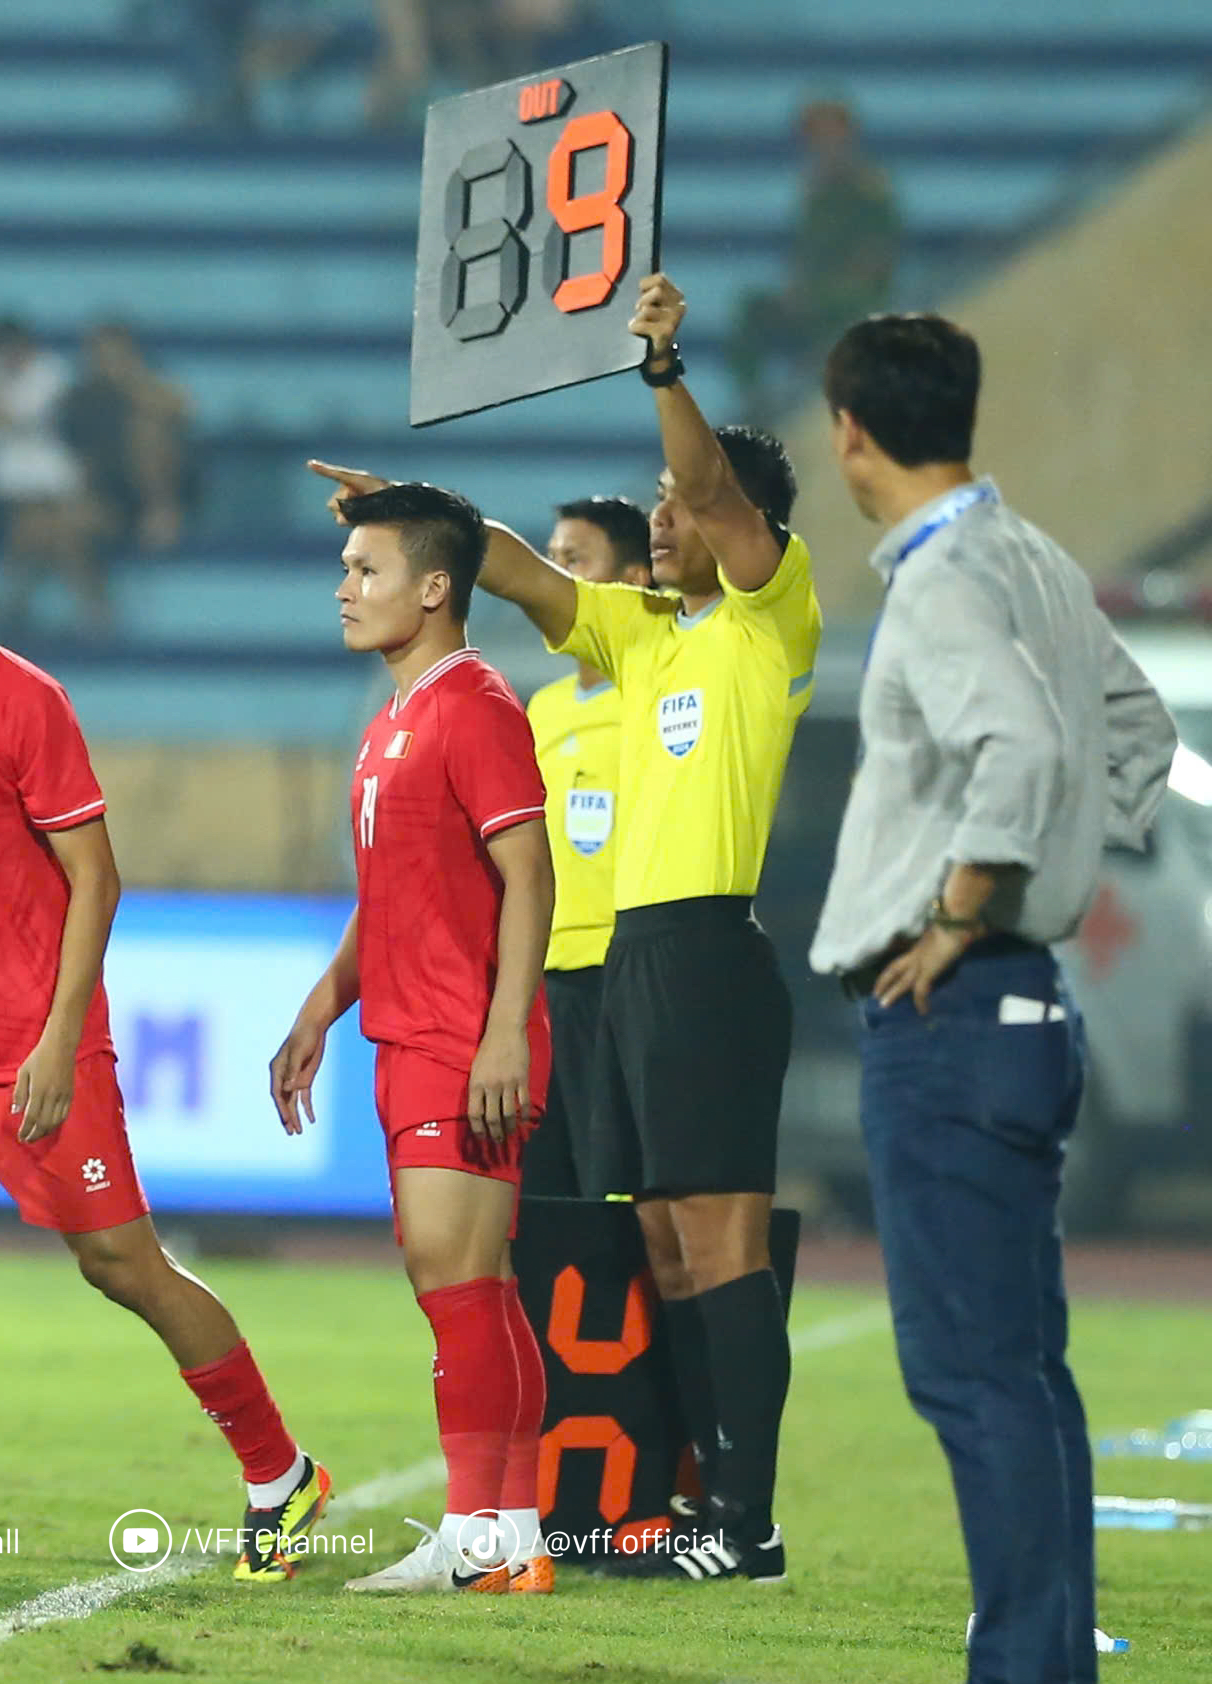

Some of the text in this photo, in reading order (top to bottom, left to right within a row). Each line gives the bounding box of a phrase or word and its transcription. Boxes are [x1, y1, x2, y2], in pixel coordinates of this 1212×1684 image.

[519, 78, 562, 122] OUT
[662, 693, 697, 715] FIFA
[570, 794, 607, 810] FIFA
